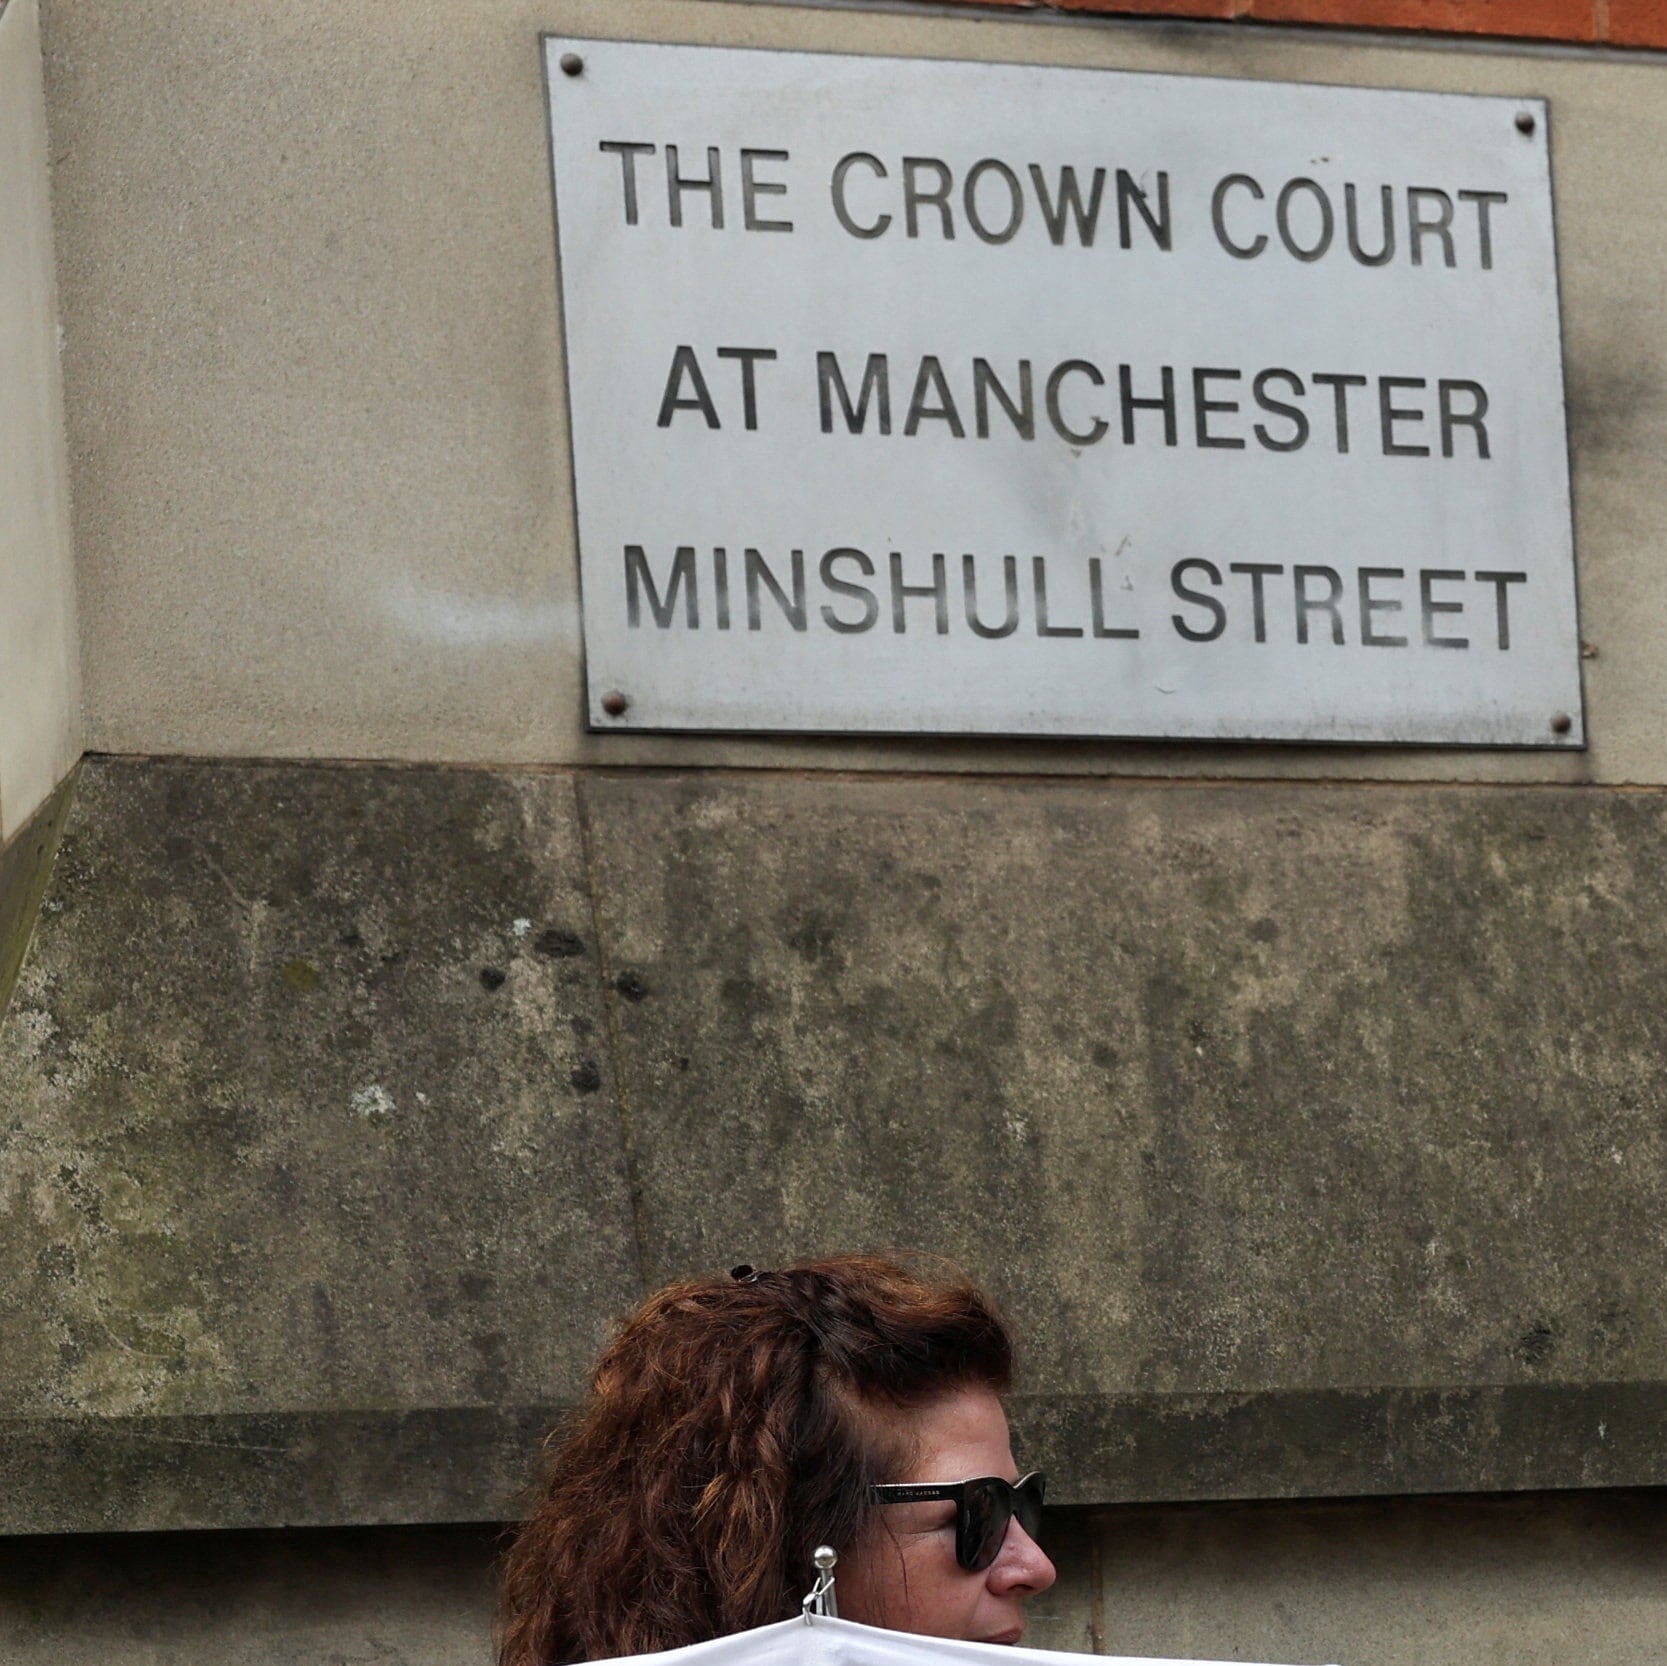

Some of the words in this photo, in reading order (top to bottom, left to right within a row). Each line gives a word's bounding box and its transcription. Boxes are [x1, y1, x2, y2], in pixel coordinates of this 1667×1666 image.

[598, 139, 794, 233] THE
[830, 151, 1172, 252] CROWN
[1210, 172, 1509, 270] COURT
[656, 344, 778, 431] AT
[816, 350, 1492, 460] MANCHESTER
[623, 544, 1141, 641] MINSHULL
[1170, 557, 1528, 651] STREET
